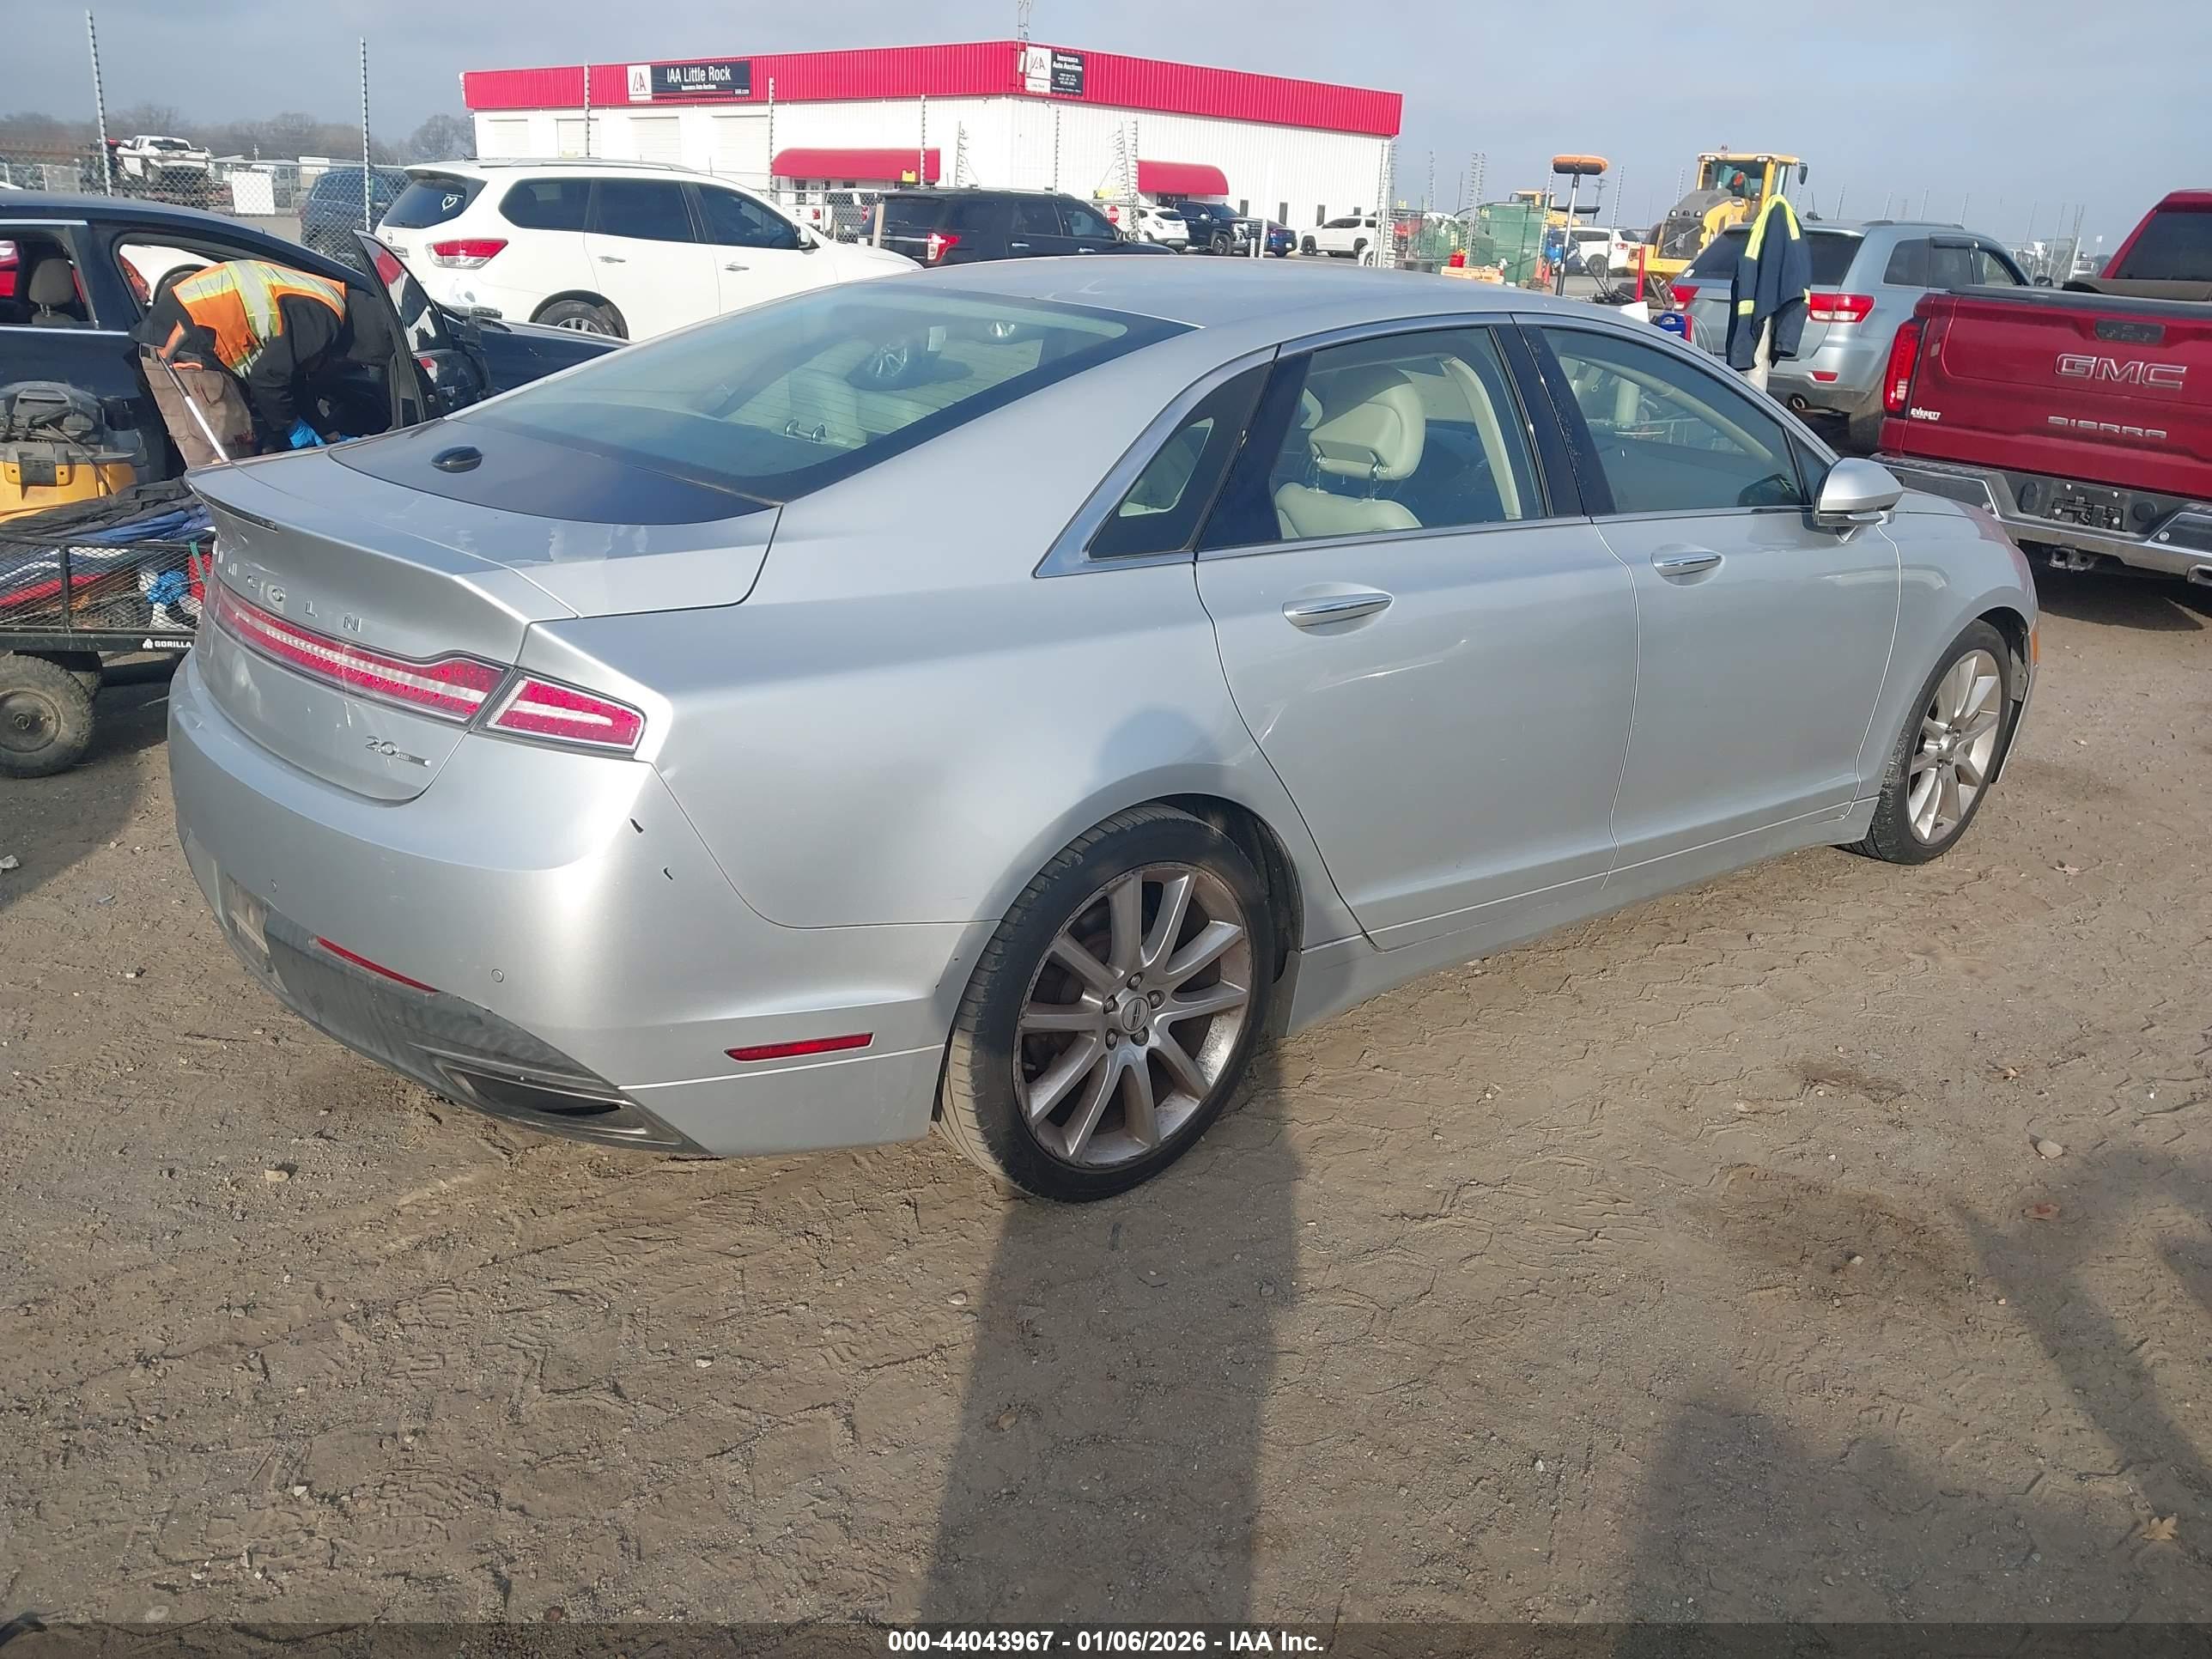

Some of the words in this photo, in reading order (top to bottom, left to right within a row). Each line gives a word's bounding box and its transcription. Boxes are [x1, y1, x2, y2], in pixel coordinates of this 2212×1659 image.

[666, 68, 682, 83] IAA
[684, 66, 706, 82] Little
[708, 64, 731, 82] Rock
[2055, 353, 2188, 390] GMC
[2047, 416, 2167, 439] SIERRA
